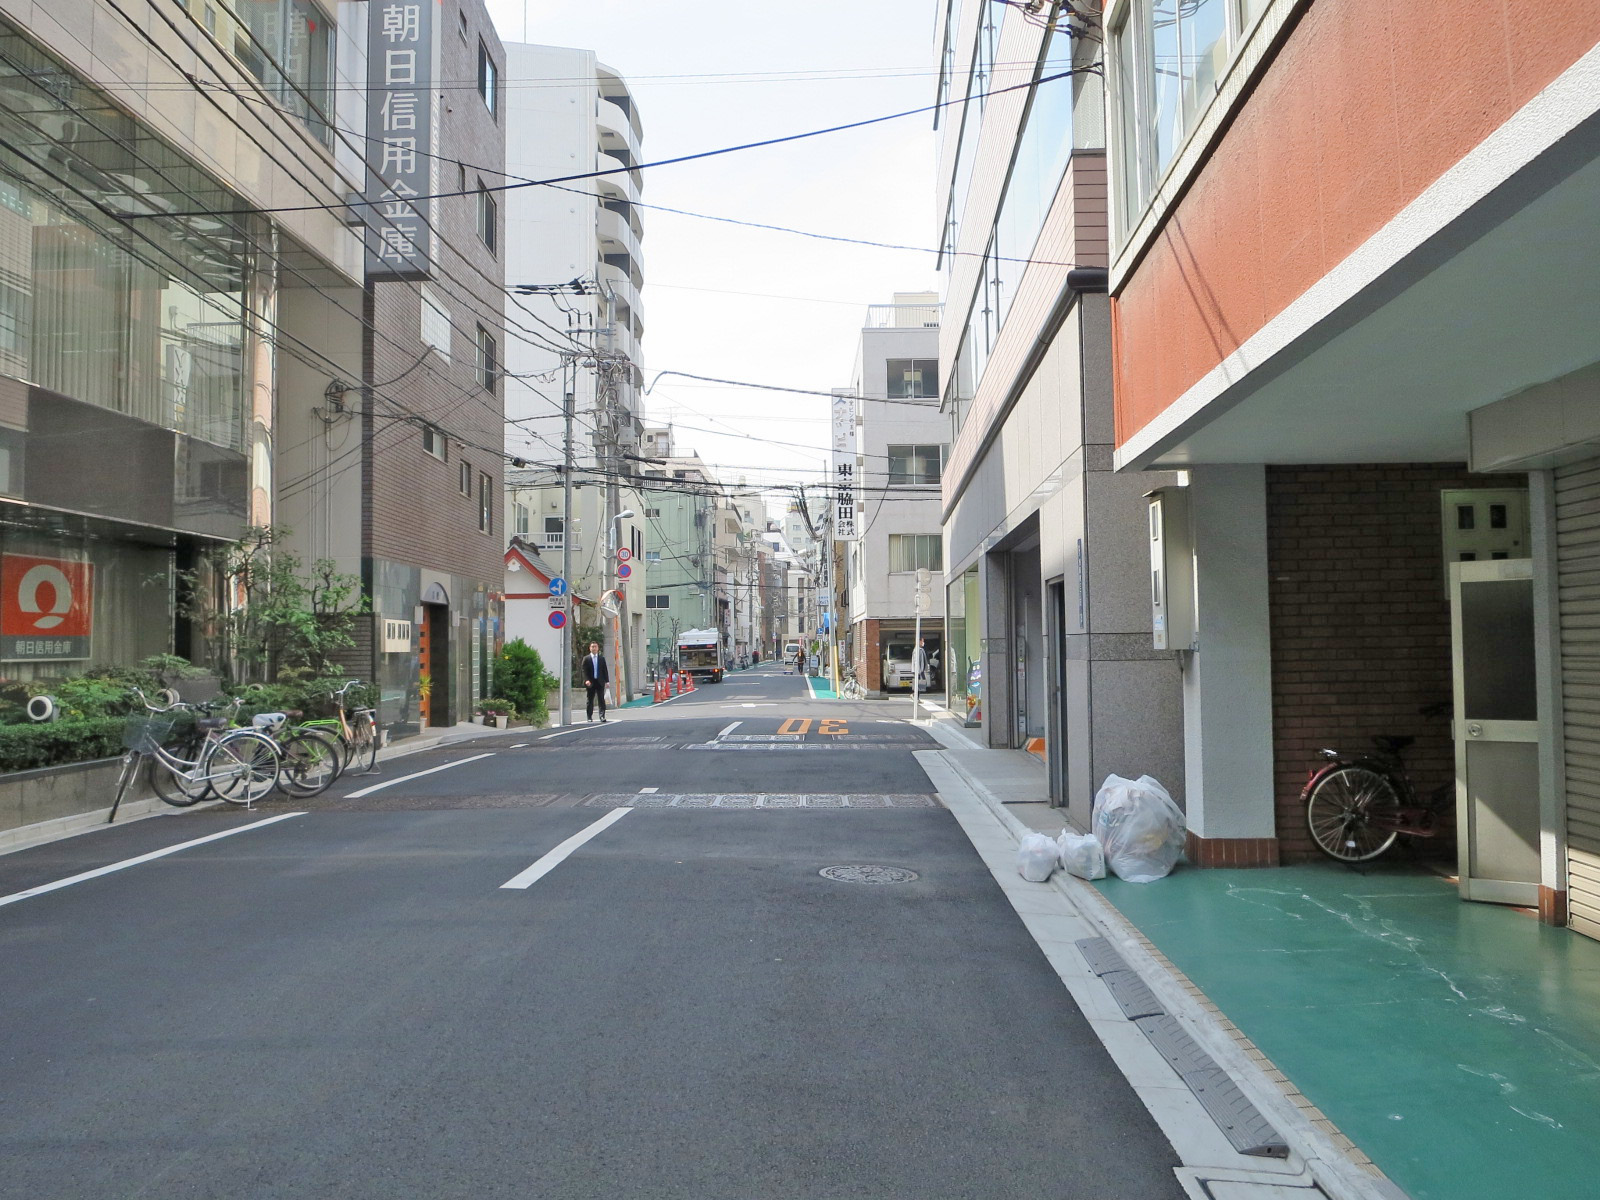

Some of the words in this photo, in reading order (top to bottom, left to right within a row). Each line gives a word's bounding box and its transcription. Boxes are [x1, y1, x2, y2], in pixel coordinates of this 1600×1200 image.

[377, 4, 420, 263] 朝日信用金庫
[16, 641, 72, 654] 朝日信用金庫
[777, 718, 848, 734] 30
